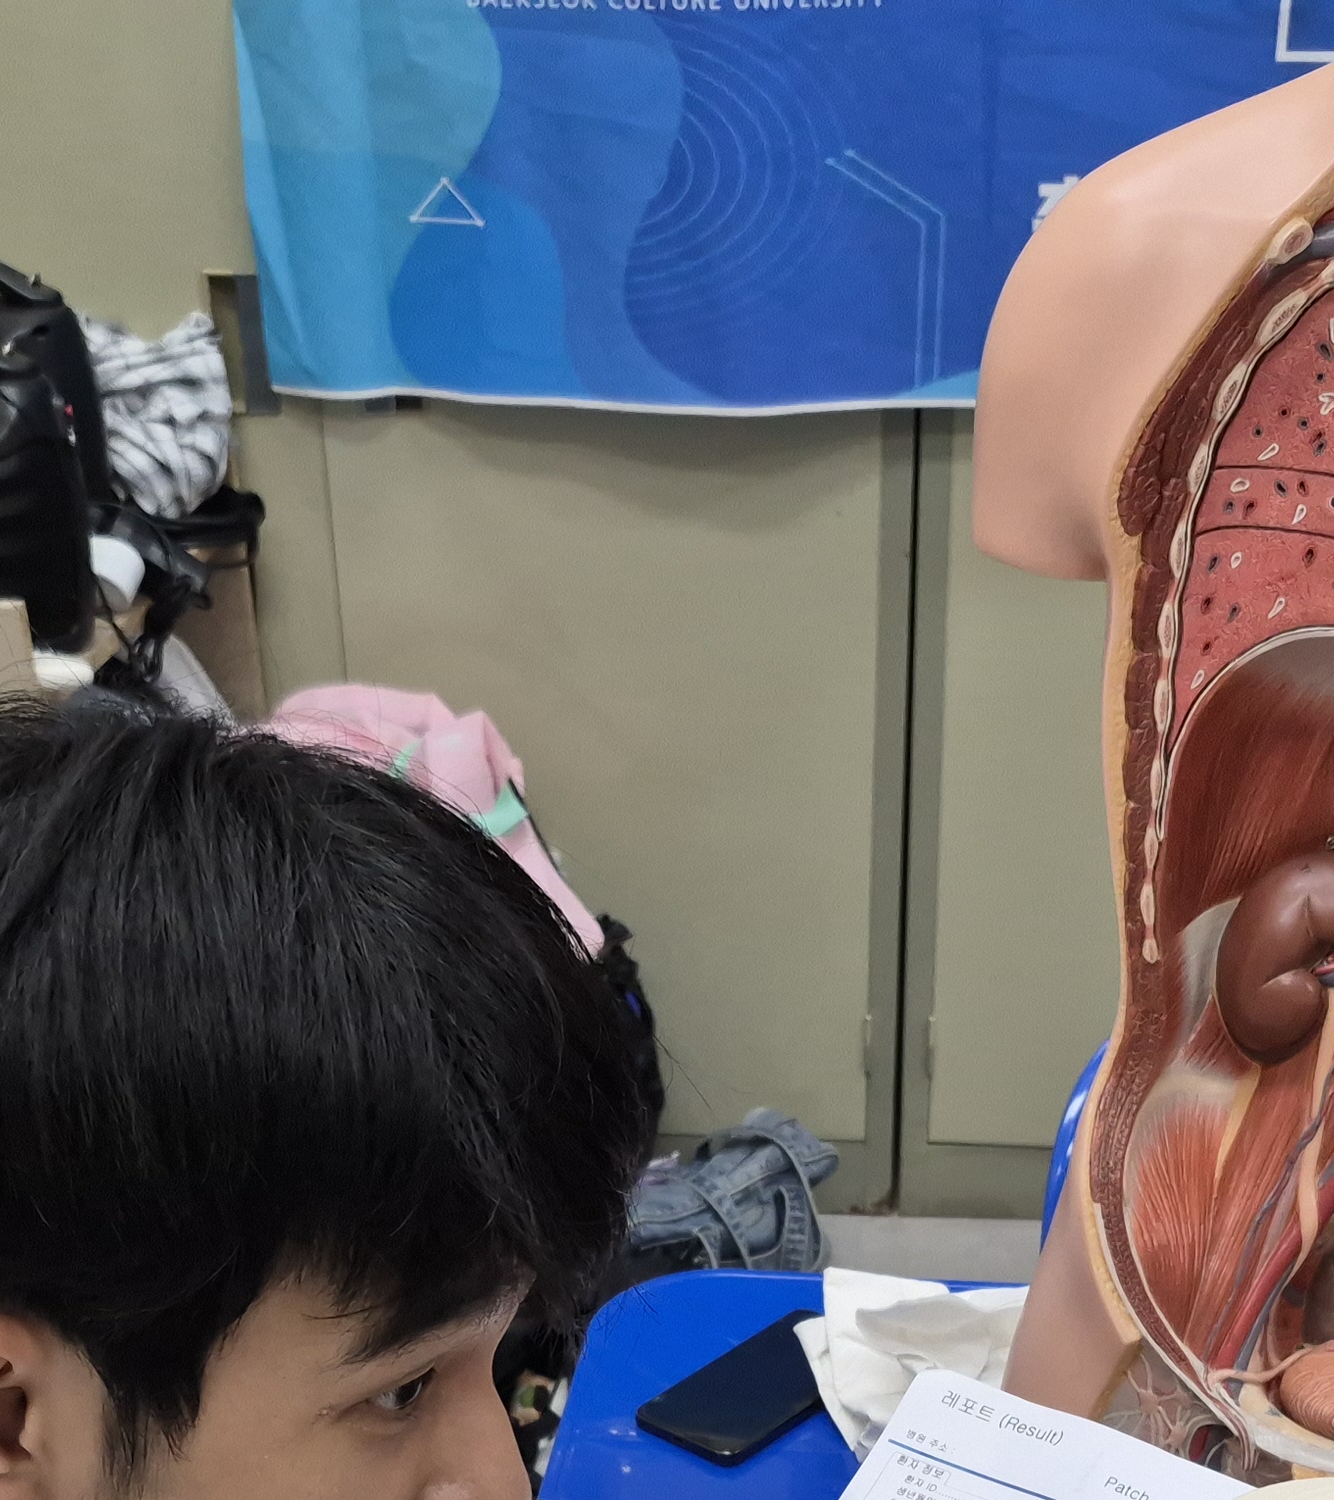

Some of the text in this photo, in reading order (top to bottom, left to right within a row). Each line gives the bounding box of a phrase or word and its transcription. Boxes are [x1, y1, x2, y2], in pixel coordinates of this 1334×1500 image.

[940, 1389, 1066, 1447] 레포트 (Result)
[905, 1428, 927, 1445] 병원
[929, 1437, 949, 1454] 주소
[896, 1454, 945, 1480] 환자 정보
[904, 1474, 938, 1494] 환자 ID
